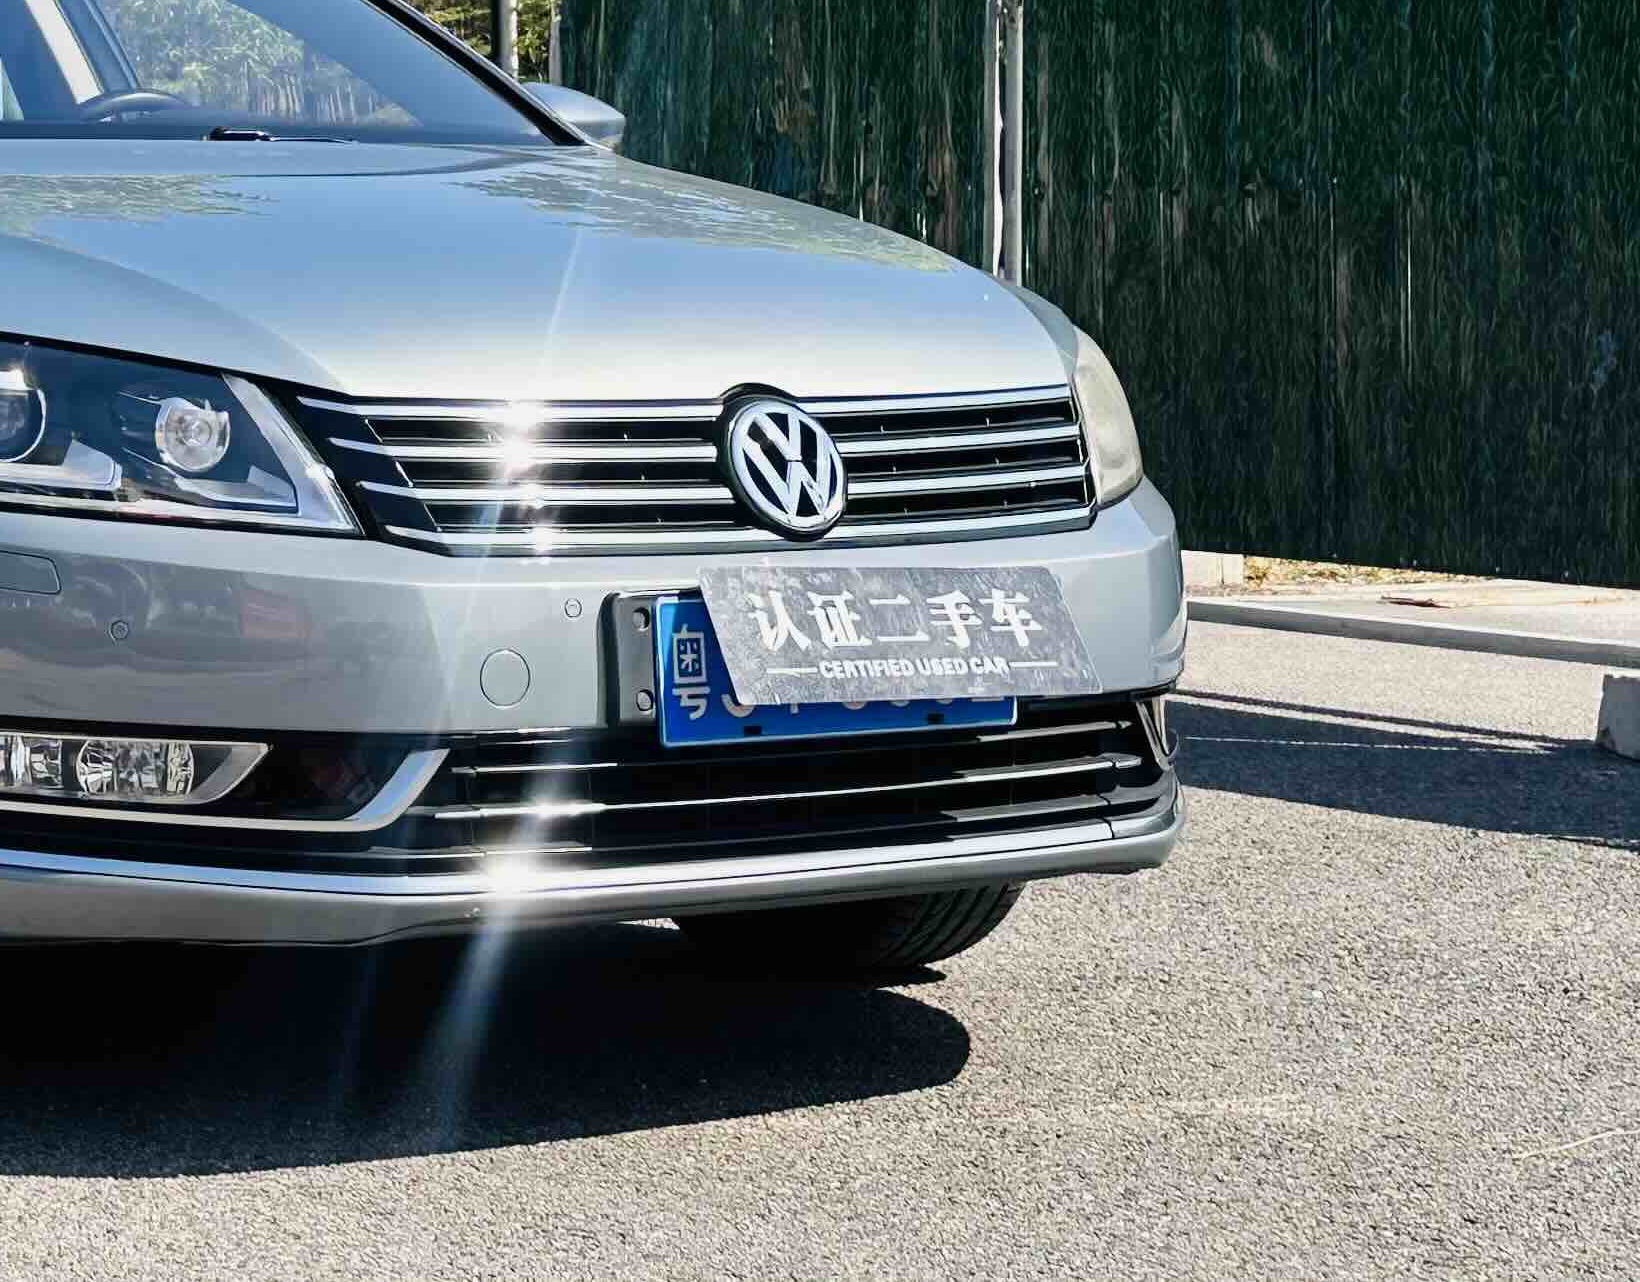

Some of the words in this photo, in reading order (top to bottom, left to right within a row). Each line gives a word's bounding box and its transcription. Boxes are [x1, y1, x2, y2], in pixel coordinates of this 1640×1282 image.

[746, 587, 1043, 652] 认证二手车
[818, 658, 915, 679] CERTIFIED
[915, 657, 969, 677] USED
[968, 656, 1010, 675] CAR
